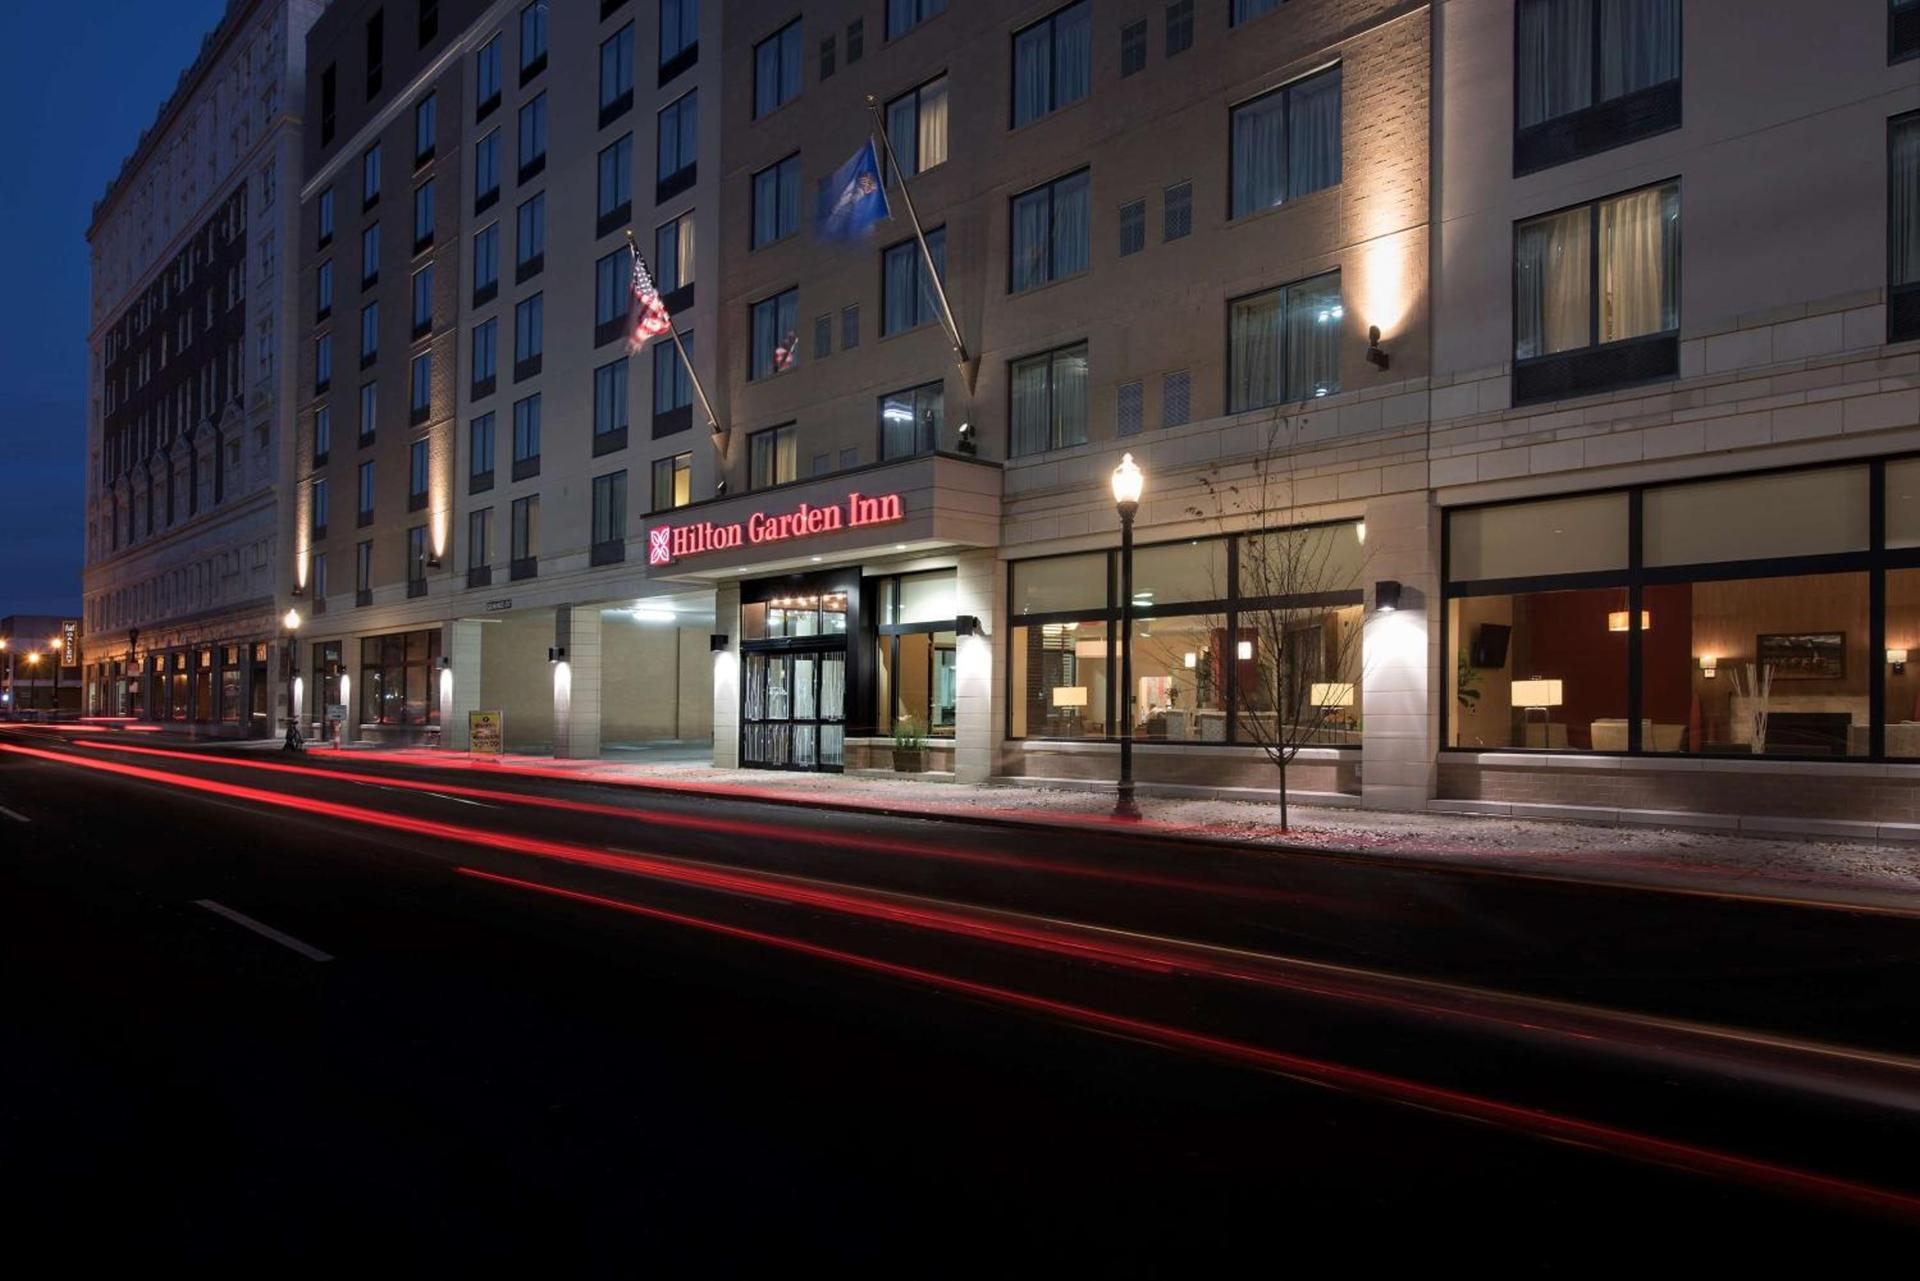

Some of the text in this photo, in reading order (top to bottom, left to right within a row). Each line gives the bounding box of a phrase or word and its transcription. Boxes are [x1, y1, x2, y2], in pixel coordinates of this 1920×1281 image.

[672, 492, 902, 556] Hilton Garden Inn
